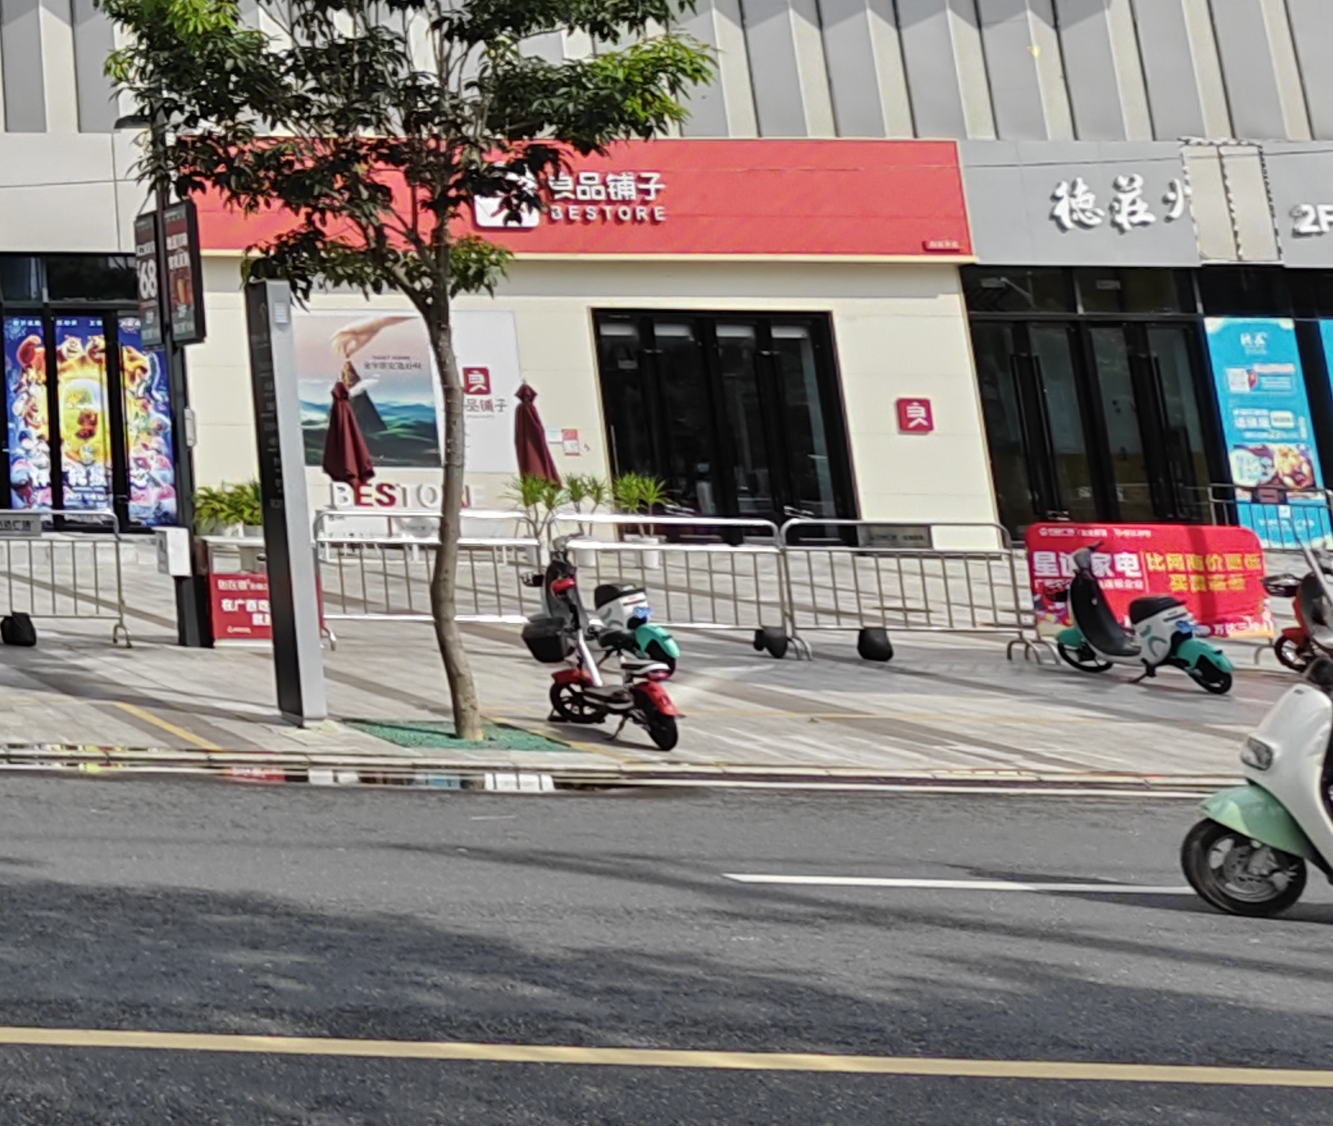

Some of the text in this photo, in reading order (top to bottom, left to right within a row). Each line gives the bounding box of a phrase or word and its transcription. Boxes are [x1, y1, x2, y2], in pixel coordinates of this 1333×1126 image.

[550, 205, 668, 222] BESTORE
[463, 398, 508, 413] 品铺子
[1145, 551, 1262, 572] 比网商价更低
